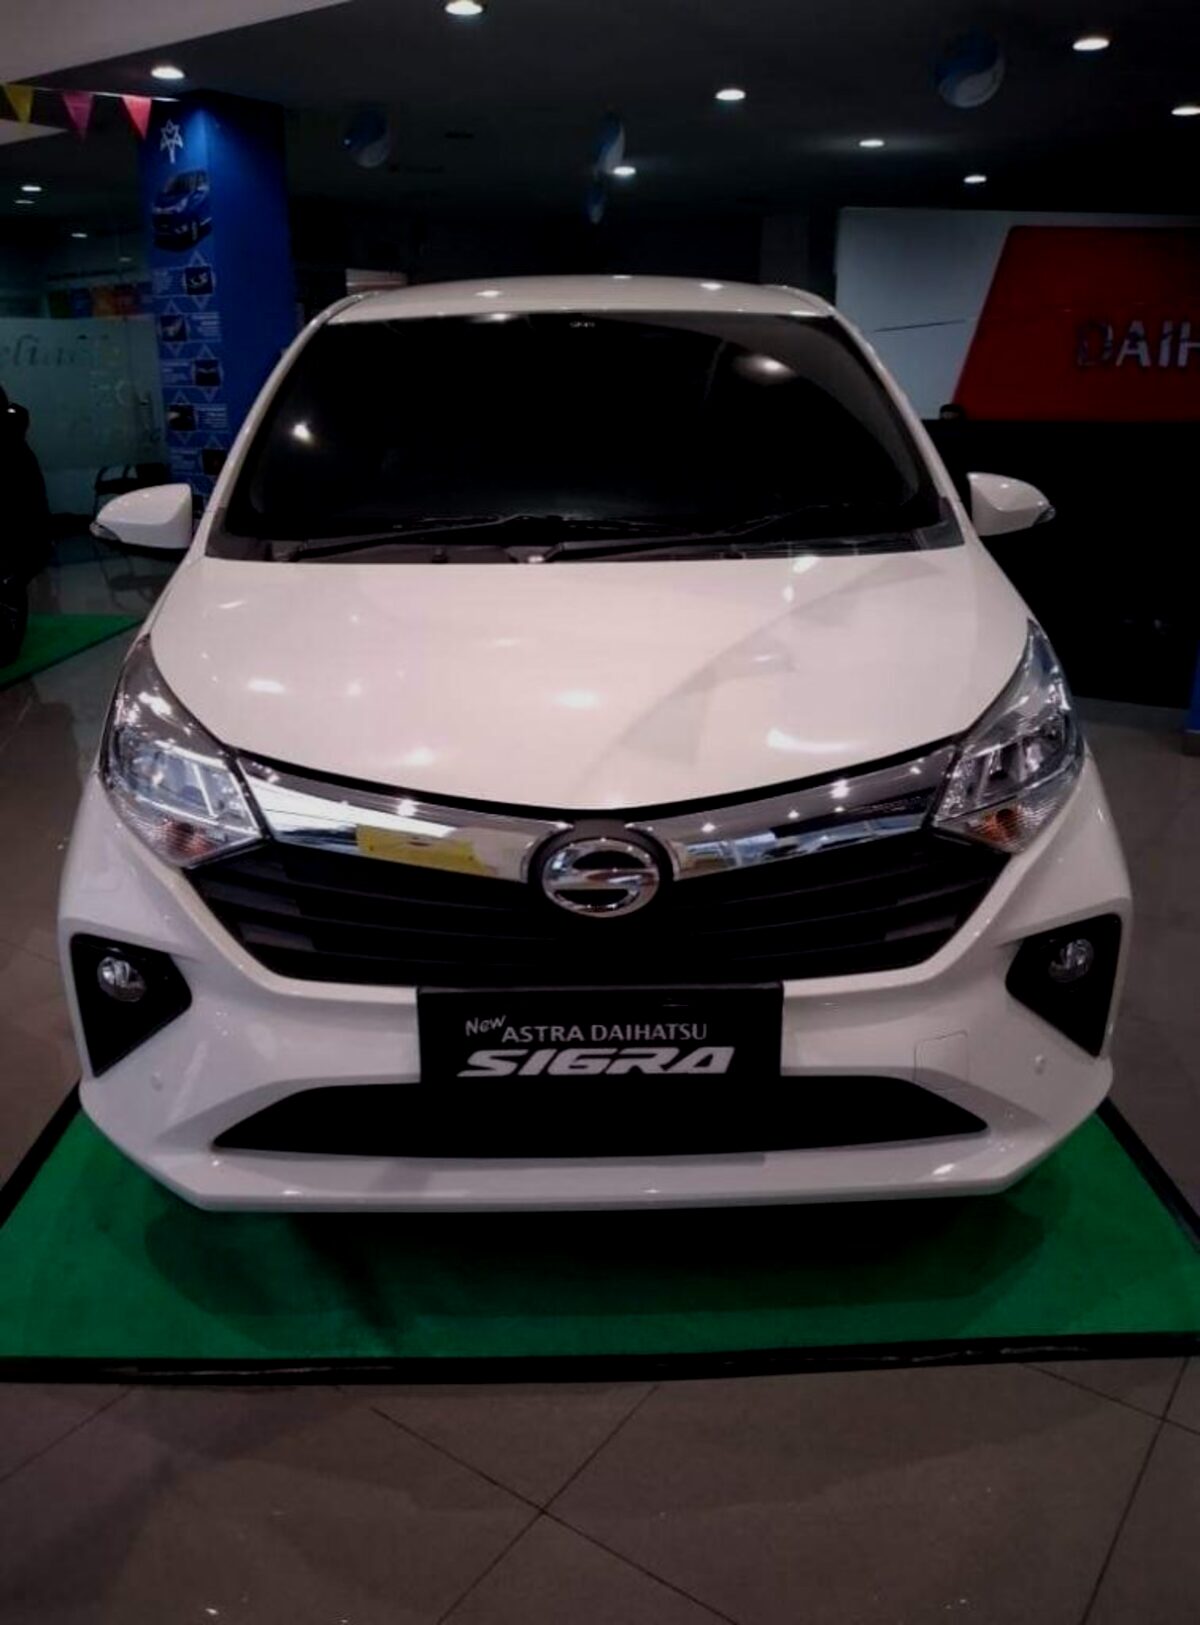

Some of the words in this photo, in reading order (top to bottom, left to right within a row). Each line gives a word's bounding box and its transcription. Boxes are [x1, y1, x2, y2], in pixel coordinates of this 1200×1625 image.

[501, 1026, 585, 1043] ASTRA
[590, 1023, 708, 1042] DAIHATSU
[457, 1046, 735, 1077] SIGRA
